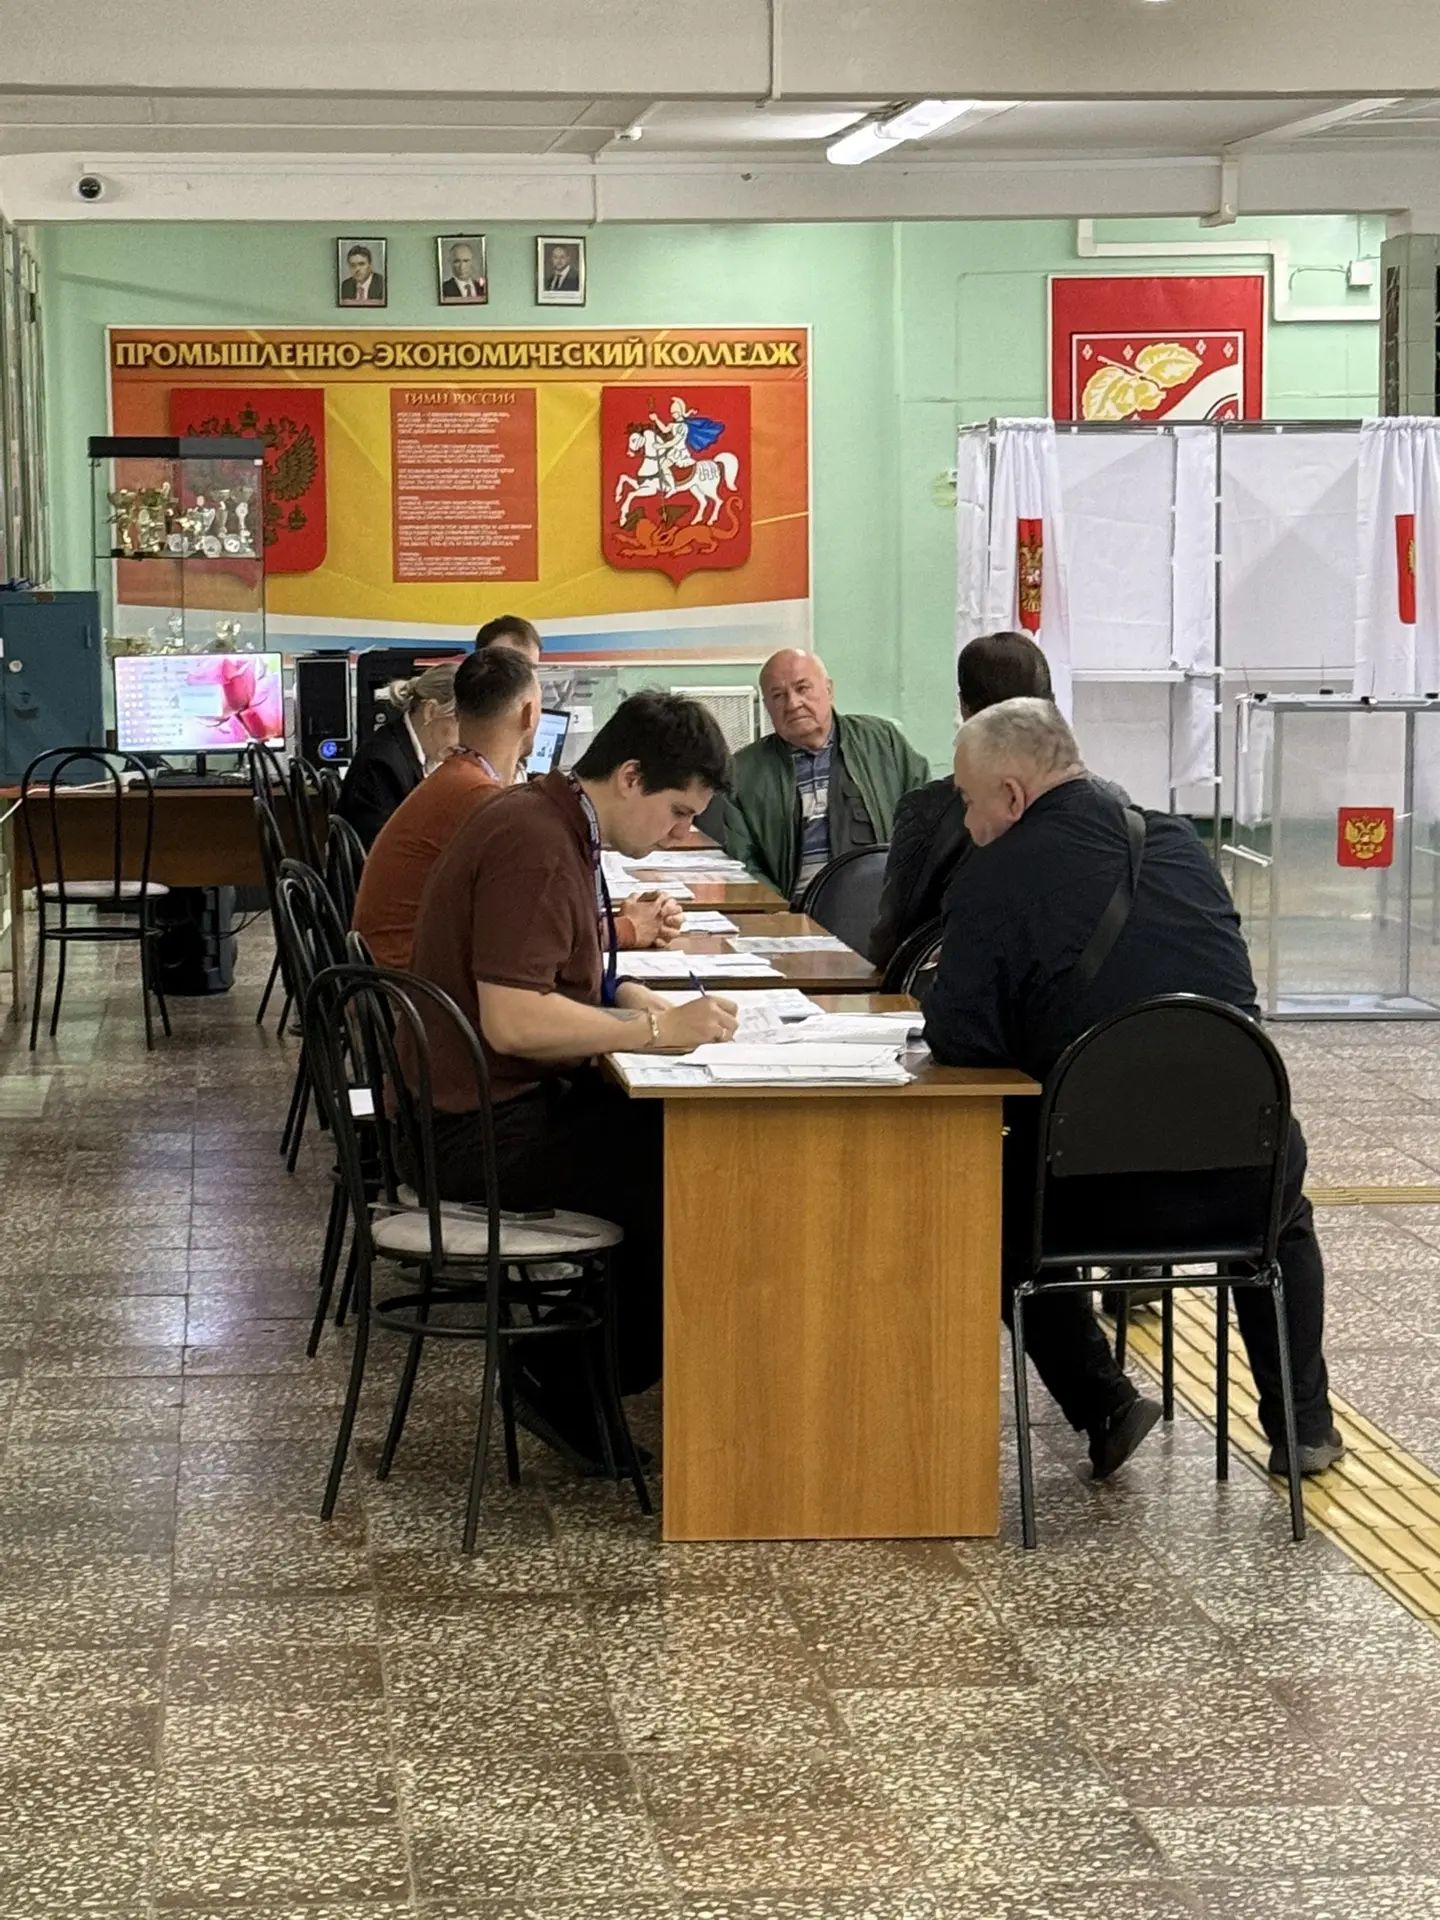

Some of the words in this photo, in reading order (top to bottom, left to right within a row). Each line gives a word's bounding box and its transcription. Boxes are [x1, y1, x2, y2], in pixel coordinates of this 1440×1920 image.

[115, 338, 645, 367] ПРОМЫШЛЕННО-ЭКОНОМИЧЕСКИЙ
[654, 342, 799, 366] КОЛЛЕДЖ
[405, 391, 449, 404] ГИМН
[452, 391, 516, 404] РОССИИ
